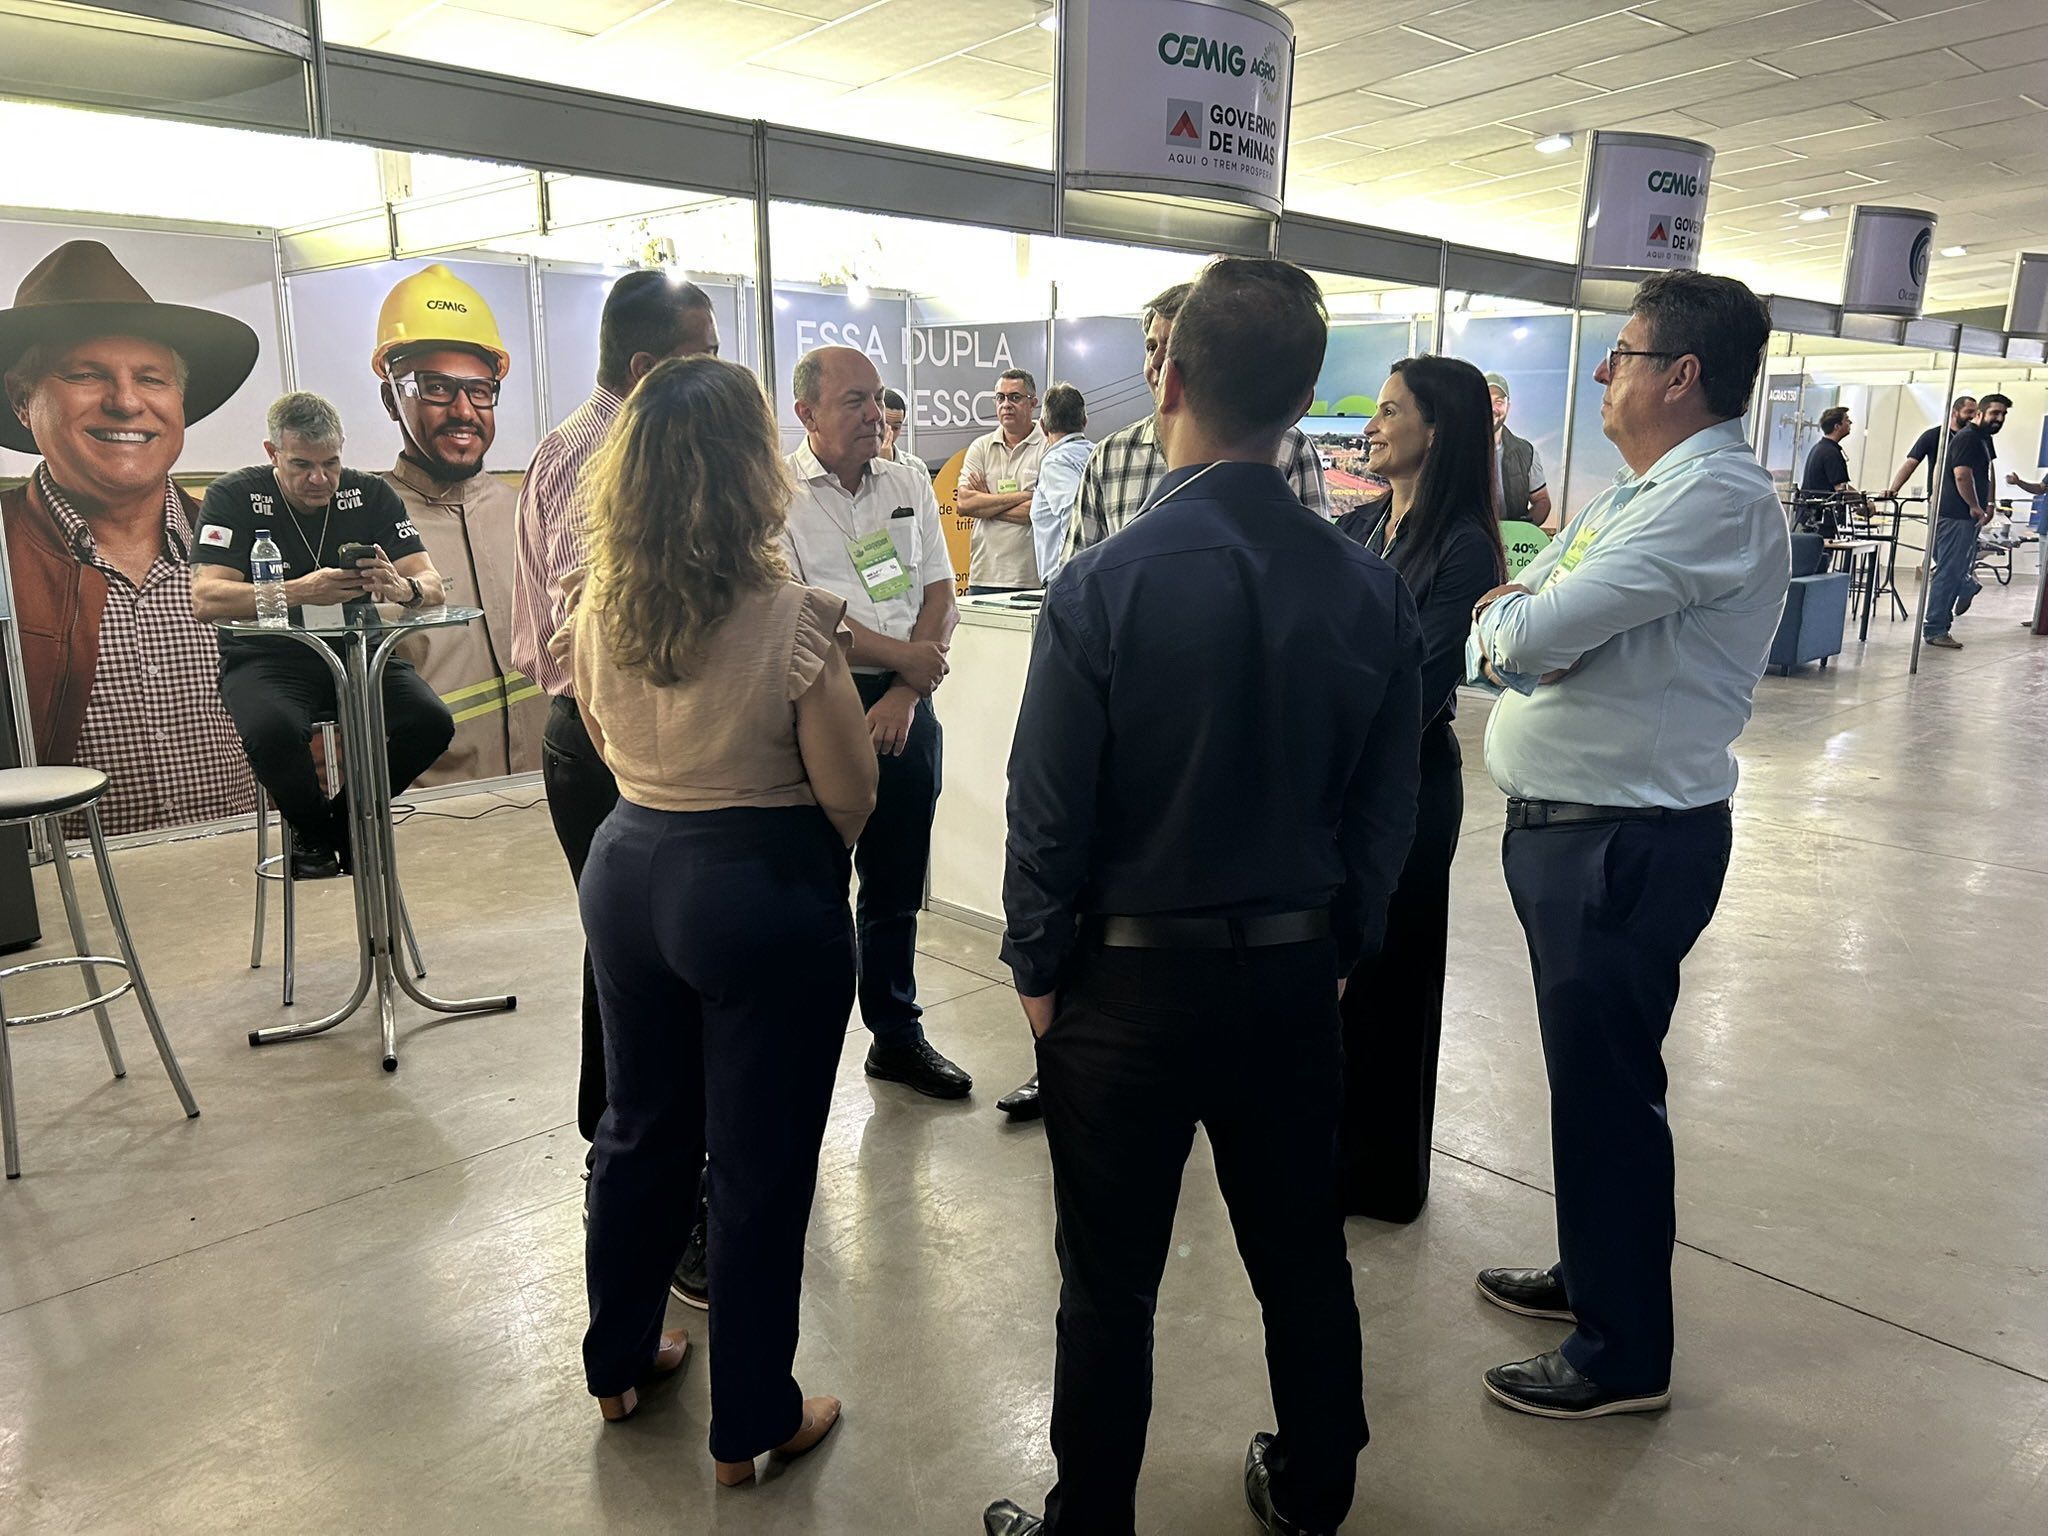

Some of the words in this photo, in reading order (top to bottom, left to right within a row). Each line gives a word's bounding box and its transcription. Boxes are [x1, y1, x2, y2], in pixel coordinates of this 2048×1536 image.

[1158, 32, 1246, 77] CEMIG
[1250, 57, 1276, 82] AGRO
[1210, 104, 1277, 139] GOVERNO
[1209, 130, 1233, 154] DE
[1238, 136, 1275, 166] MINAS
[1168, 153, 1196, 165] AQUI
[1201, 156, 1208, 167] O
[1213, 158, 1237, 171] TREM
[1647, 170, 1697, 197] CEMIG
[1672, 234, 1686, 250] DE
[426, 300, 468, 314] CEMIG
[903, 326, 1015, 370] DUPLA
[336, 496, 363, 511] CIVIL
[1512, 542, 1539, 555] 40%
